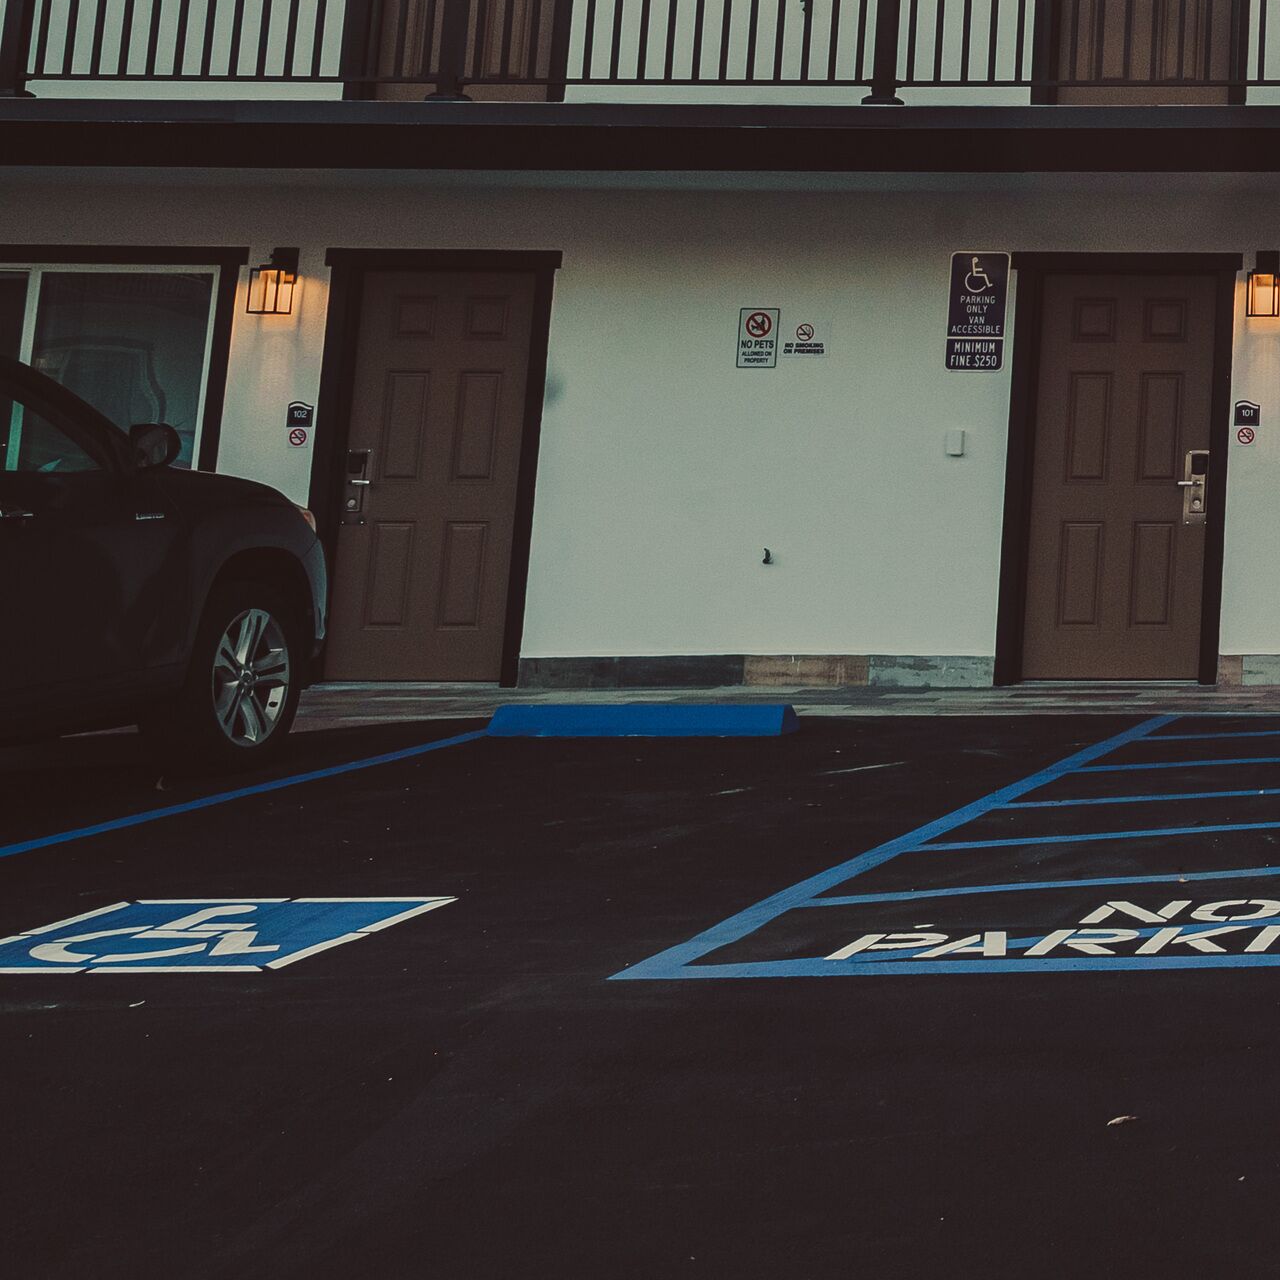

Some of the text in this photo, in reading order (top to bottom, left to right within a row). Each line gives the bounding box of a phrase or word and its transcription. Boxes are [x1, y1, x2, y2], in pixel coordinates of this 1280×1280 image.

[960, 295, 996, 304] PARKING
[966, 305, 988, 313] ONLY
[969, 316, 985, 324] VAN
[951, 325, 1000, 334] ACCESSIBLE
[741, 340, 774, 349] NO PETS
[954, 342, 996, 353] MINIMUM
[950, 355, 997, 368] FINE $250
[293, 410, 308, 418] 102
[1242, 409, 1254, 417] 101
